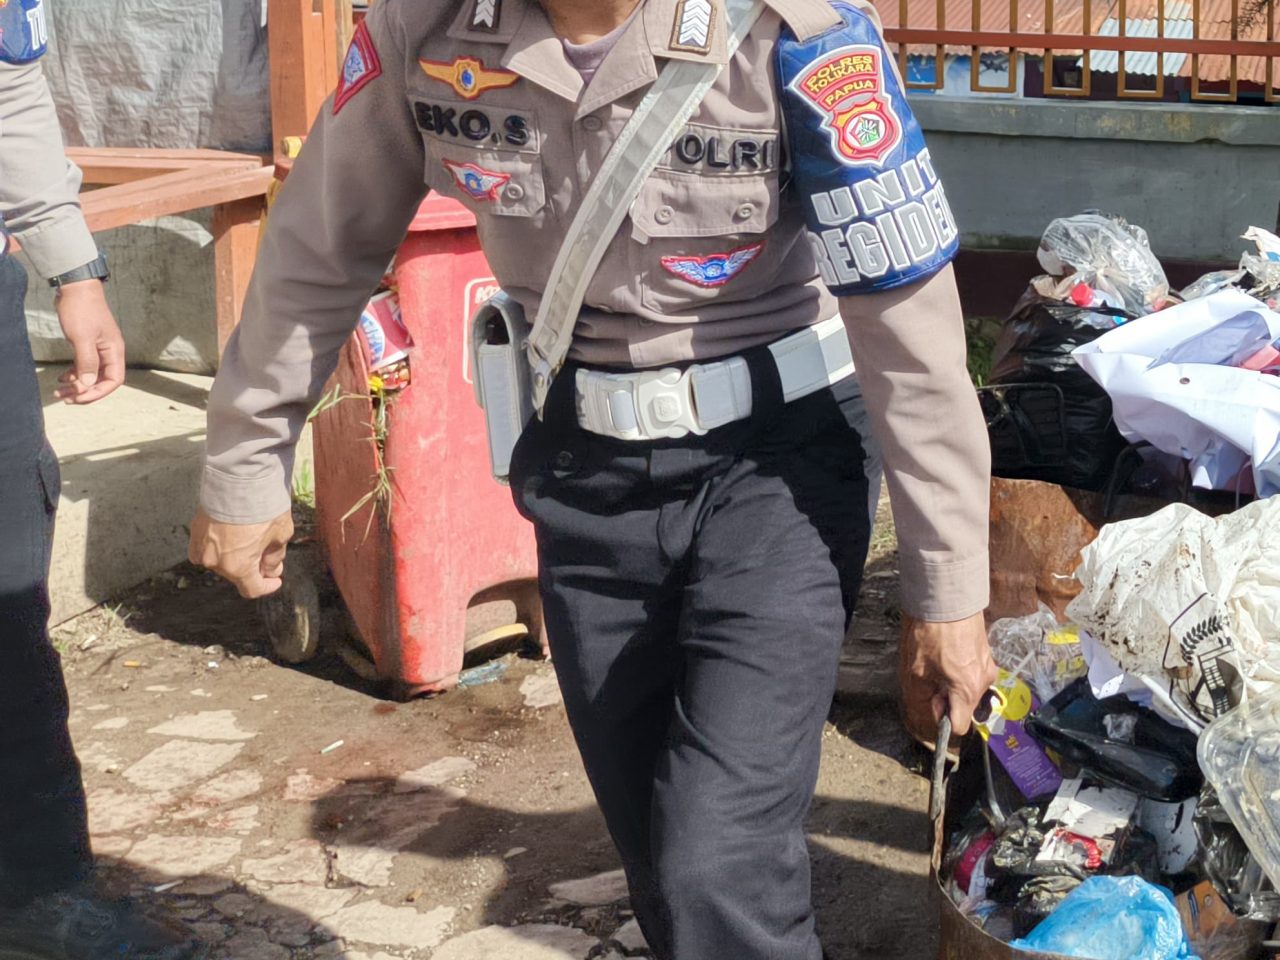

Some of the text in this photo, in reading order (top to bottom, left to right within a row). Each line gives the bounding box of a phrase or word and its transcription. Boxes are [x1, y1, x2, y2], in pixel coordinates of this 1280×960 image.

[806, 55, 872, 87] POLRES
[811, 62, 873, 92] TOLIKARA
[825, 79, 874, 105] PAPUA
[674, 132, 776, 169] OLRI
[810, 147, 937, 227] UNIT
